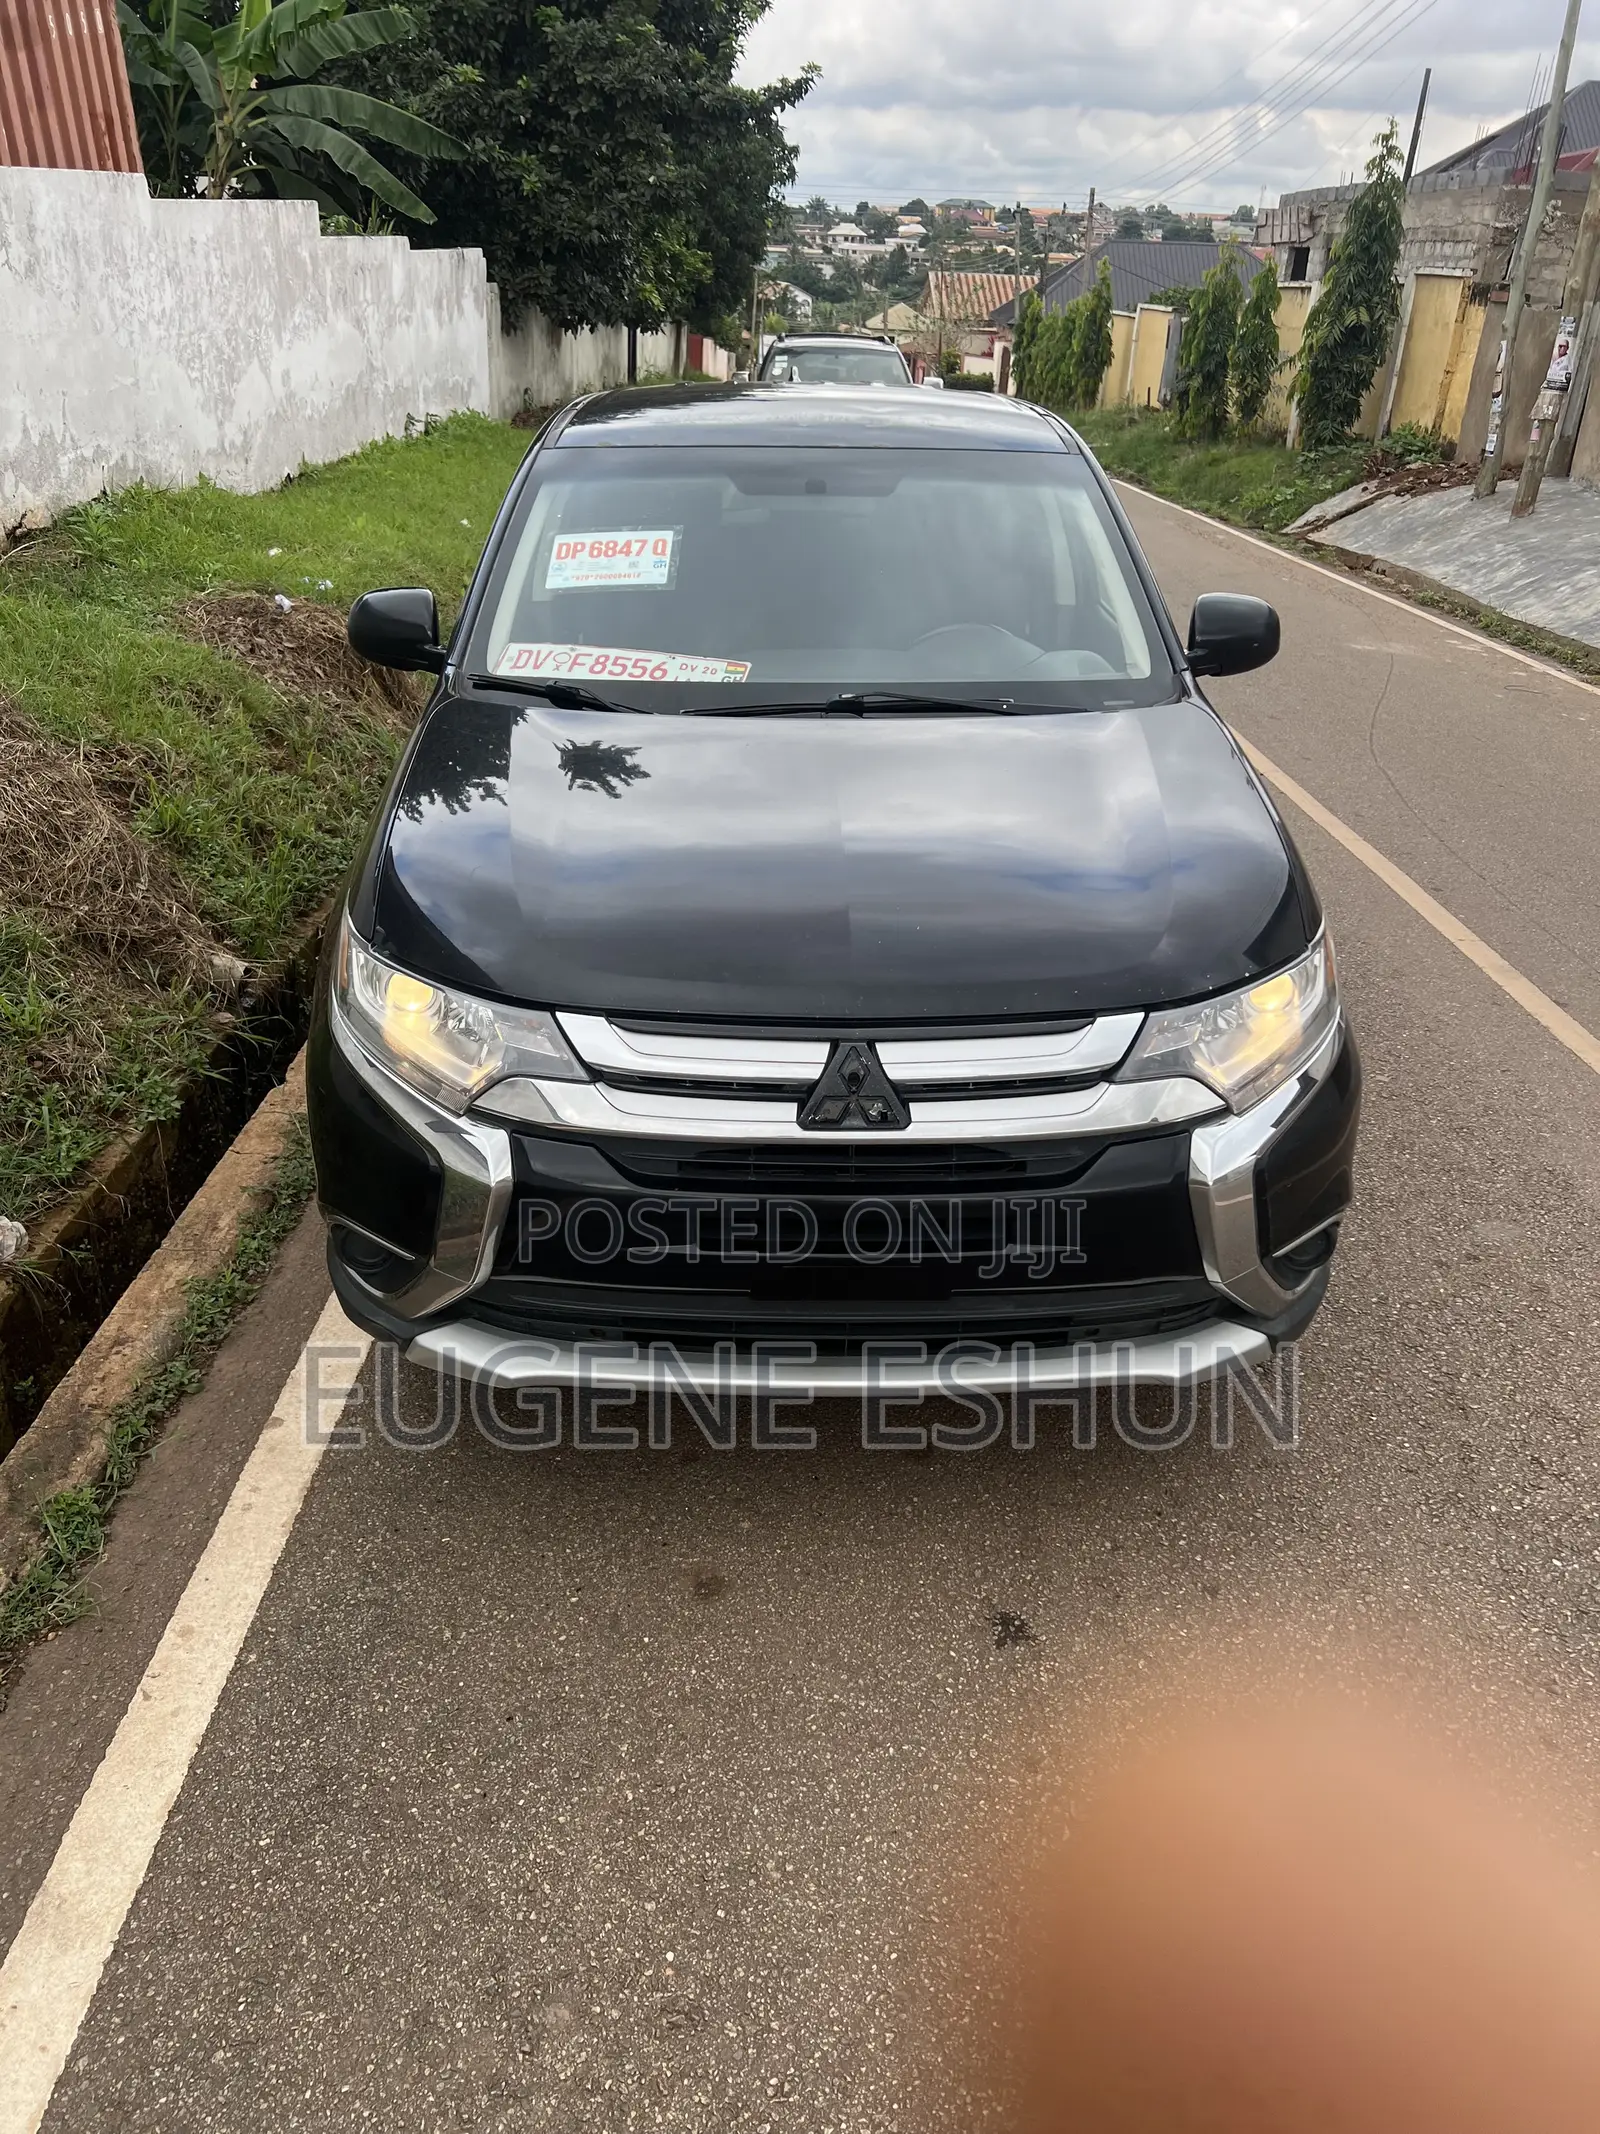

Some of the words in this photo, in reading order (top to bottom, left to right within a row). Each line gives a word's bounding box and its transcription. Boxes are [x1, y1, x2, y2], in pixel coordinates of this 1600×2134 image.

[555, 541, 586, 560] DP
[588, 539, 648, 559] 6847
[652, 538, 668, 556] Q
[509, 649, 554, 670] DV
[567, 653, 668, 681] F8556
[679, 662, 698, 673] DV
[702, 666, 718, 675] 20
